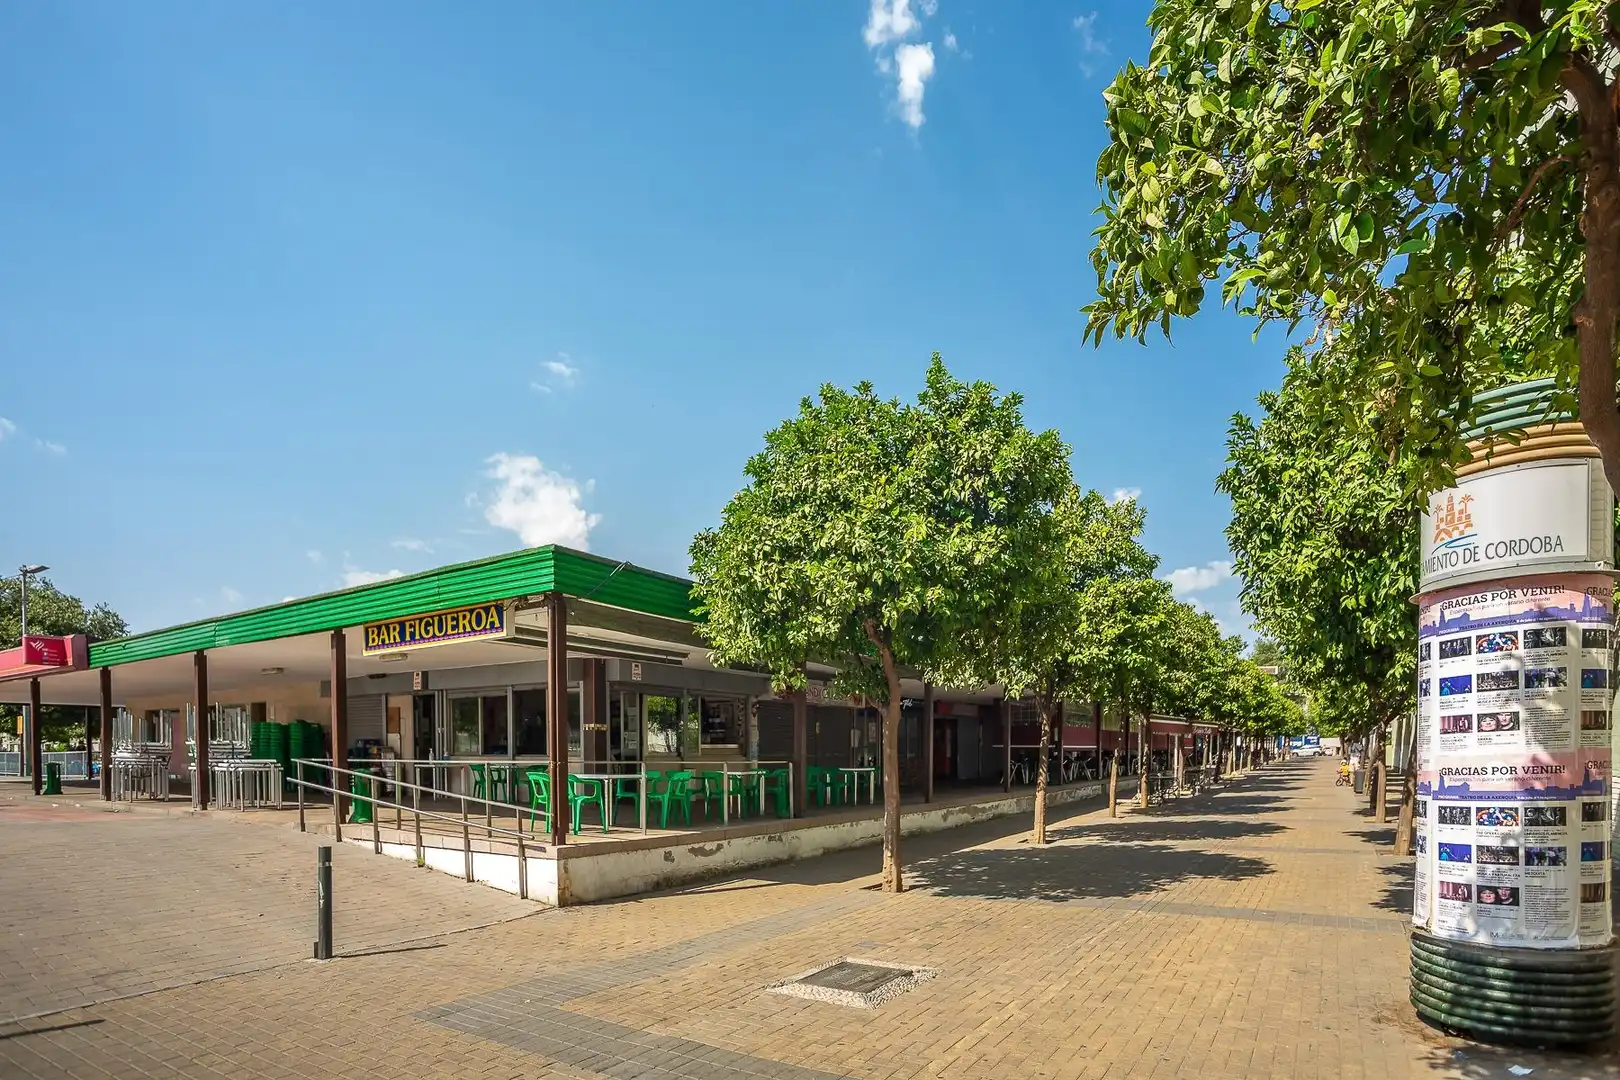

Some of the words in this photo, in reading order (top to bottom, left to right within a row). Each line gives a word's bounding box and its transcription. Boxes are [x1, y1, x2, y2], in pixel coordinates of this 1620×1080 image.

[1463, 545, 1480, 565] DE
[1485, 535, 1564, 560] CORDOBA
[1440, 594, 1488, 611] ¡GRACIAS
[1490, 589, 1517, 602] POR
[1521, 585, 1565, 597] VENIR!
[367, 622, 401, 647] BAR
[404, 605, 501, 642] FIGUEROA
[1439, 767, 1488, 776] ¡GRACIAS
[1491, 766, 1518, 776] POR
[1522, 764, 1565, 775] VENIR!
